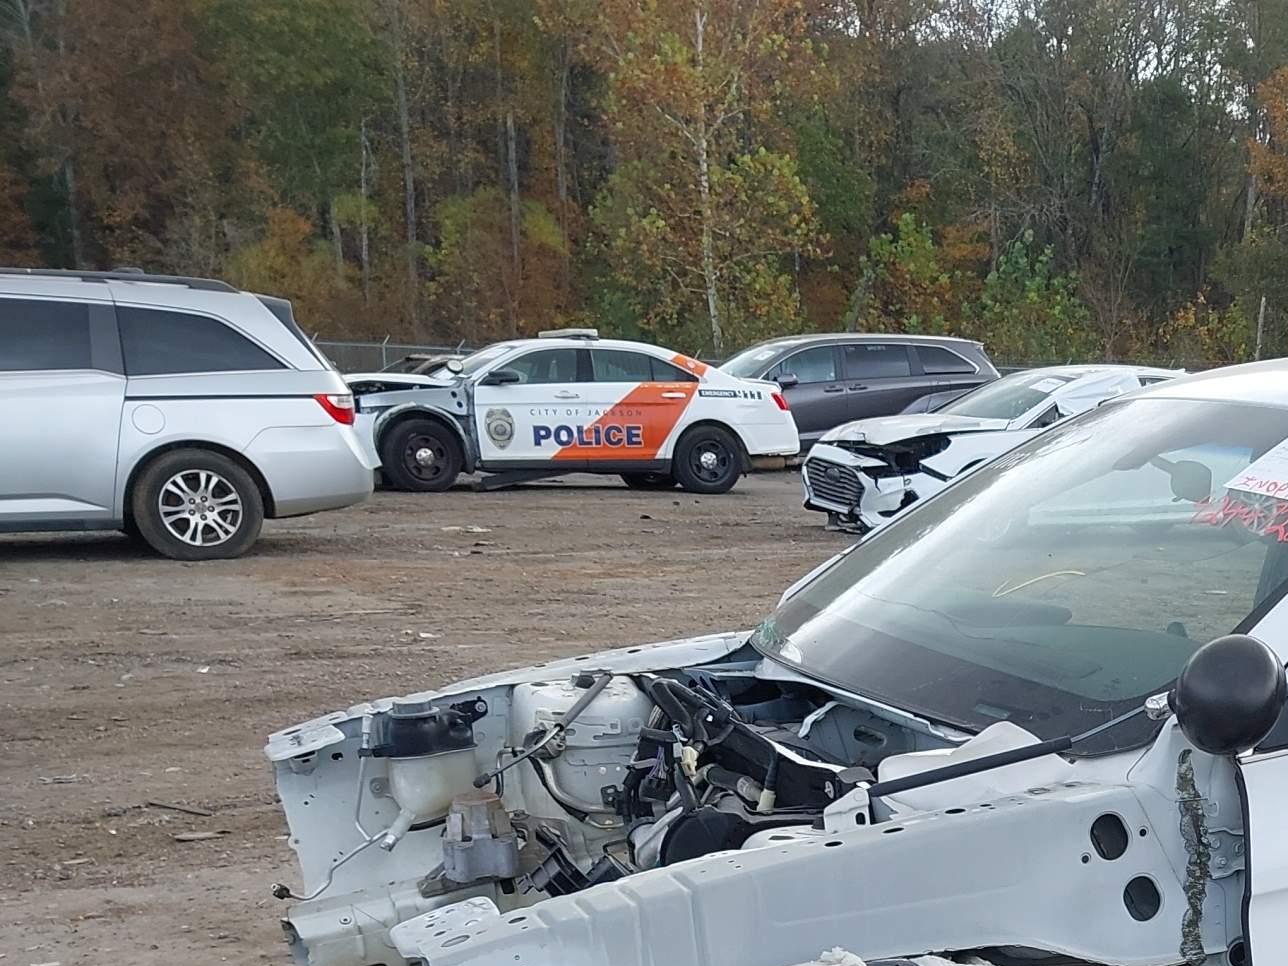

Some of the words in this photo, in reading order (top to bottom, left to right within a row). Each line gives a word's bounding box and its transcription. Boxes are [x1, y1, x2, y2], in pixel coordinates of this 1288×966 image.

[529, 408, 558, 416] CITY
[587, 409, 642, 417] JACKSON
[532, 424, 644, 447] POLICE
